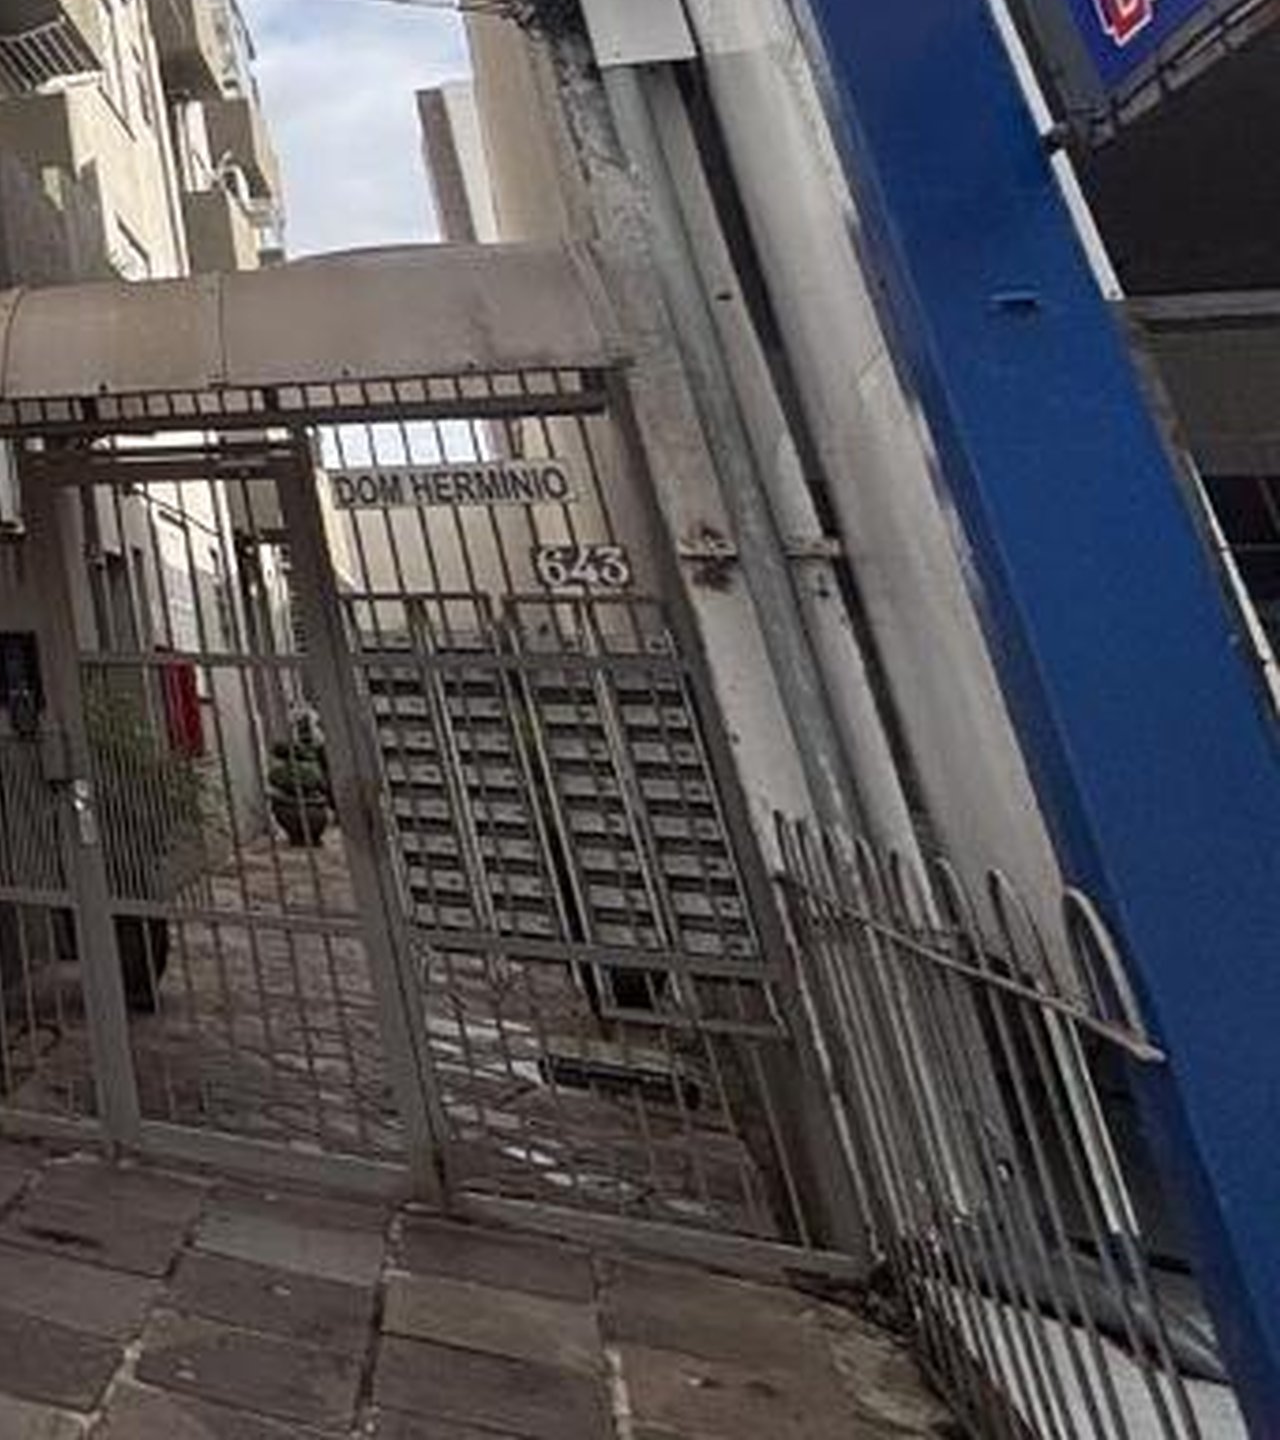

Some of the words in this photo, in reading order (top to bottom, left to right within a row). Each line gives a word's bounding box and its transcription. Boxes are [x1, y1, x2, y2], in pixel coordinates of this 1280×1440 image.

[334, 474, 403, 505] DOM
[409, 466, 569, 501] HERMINIO
[537, 546, 630, 588] 643
